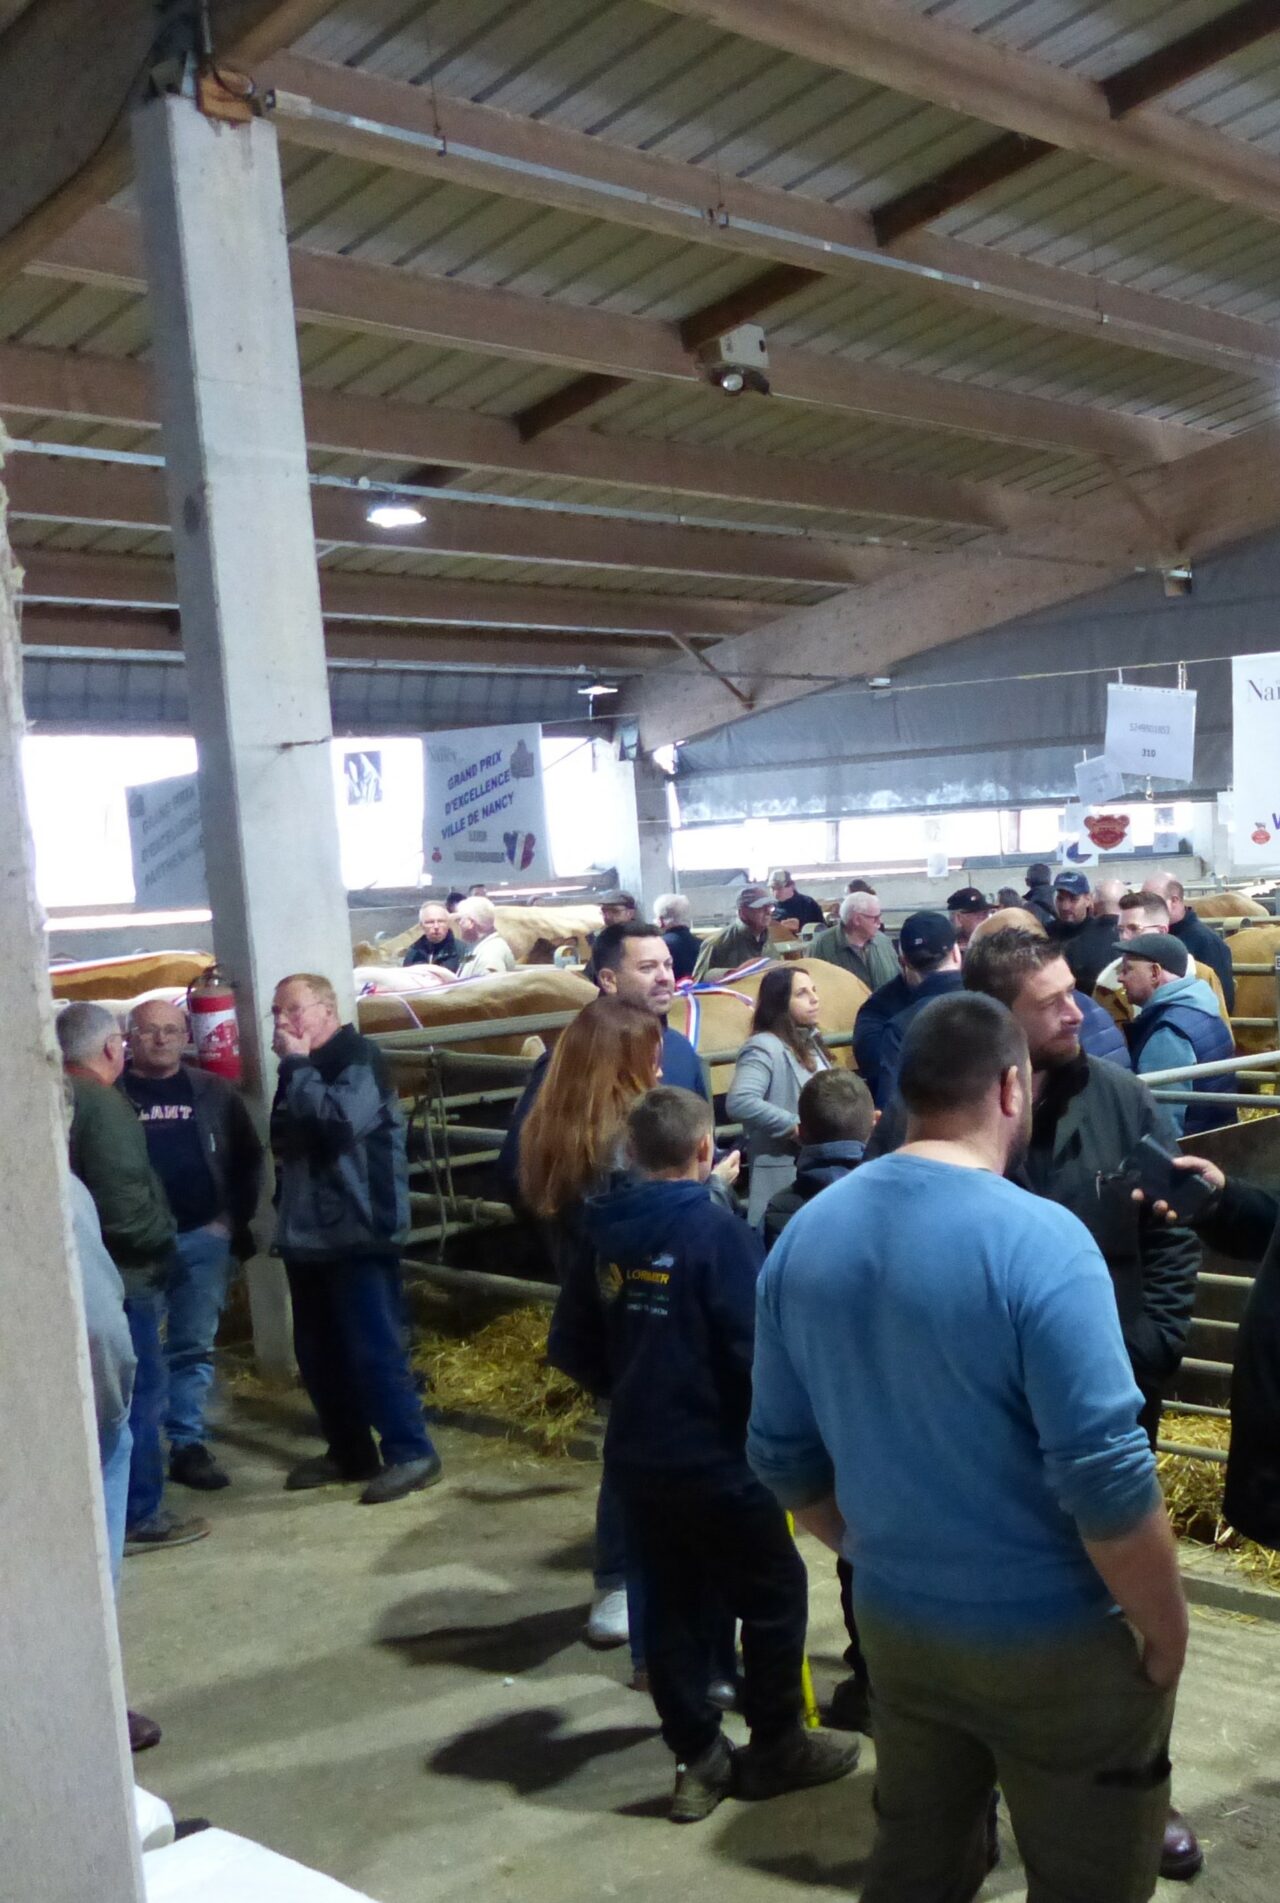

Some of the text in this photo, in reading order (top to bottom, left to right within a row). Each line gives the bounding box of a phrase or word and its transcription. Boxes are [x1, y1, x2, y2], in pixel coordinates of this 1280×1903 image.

[444, 768, 512, 816] D'EXCELLENCE
[447, 750, 502, 790] GRAND PRIX
[441, 817, 466, 840] VILLE
[467, 810, 480, 826] DE
[482, 791, 514, 819] NANCY
